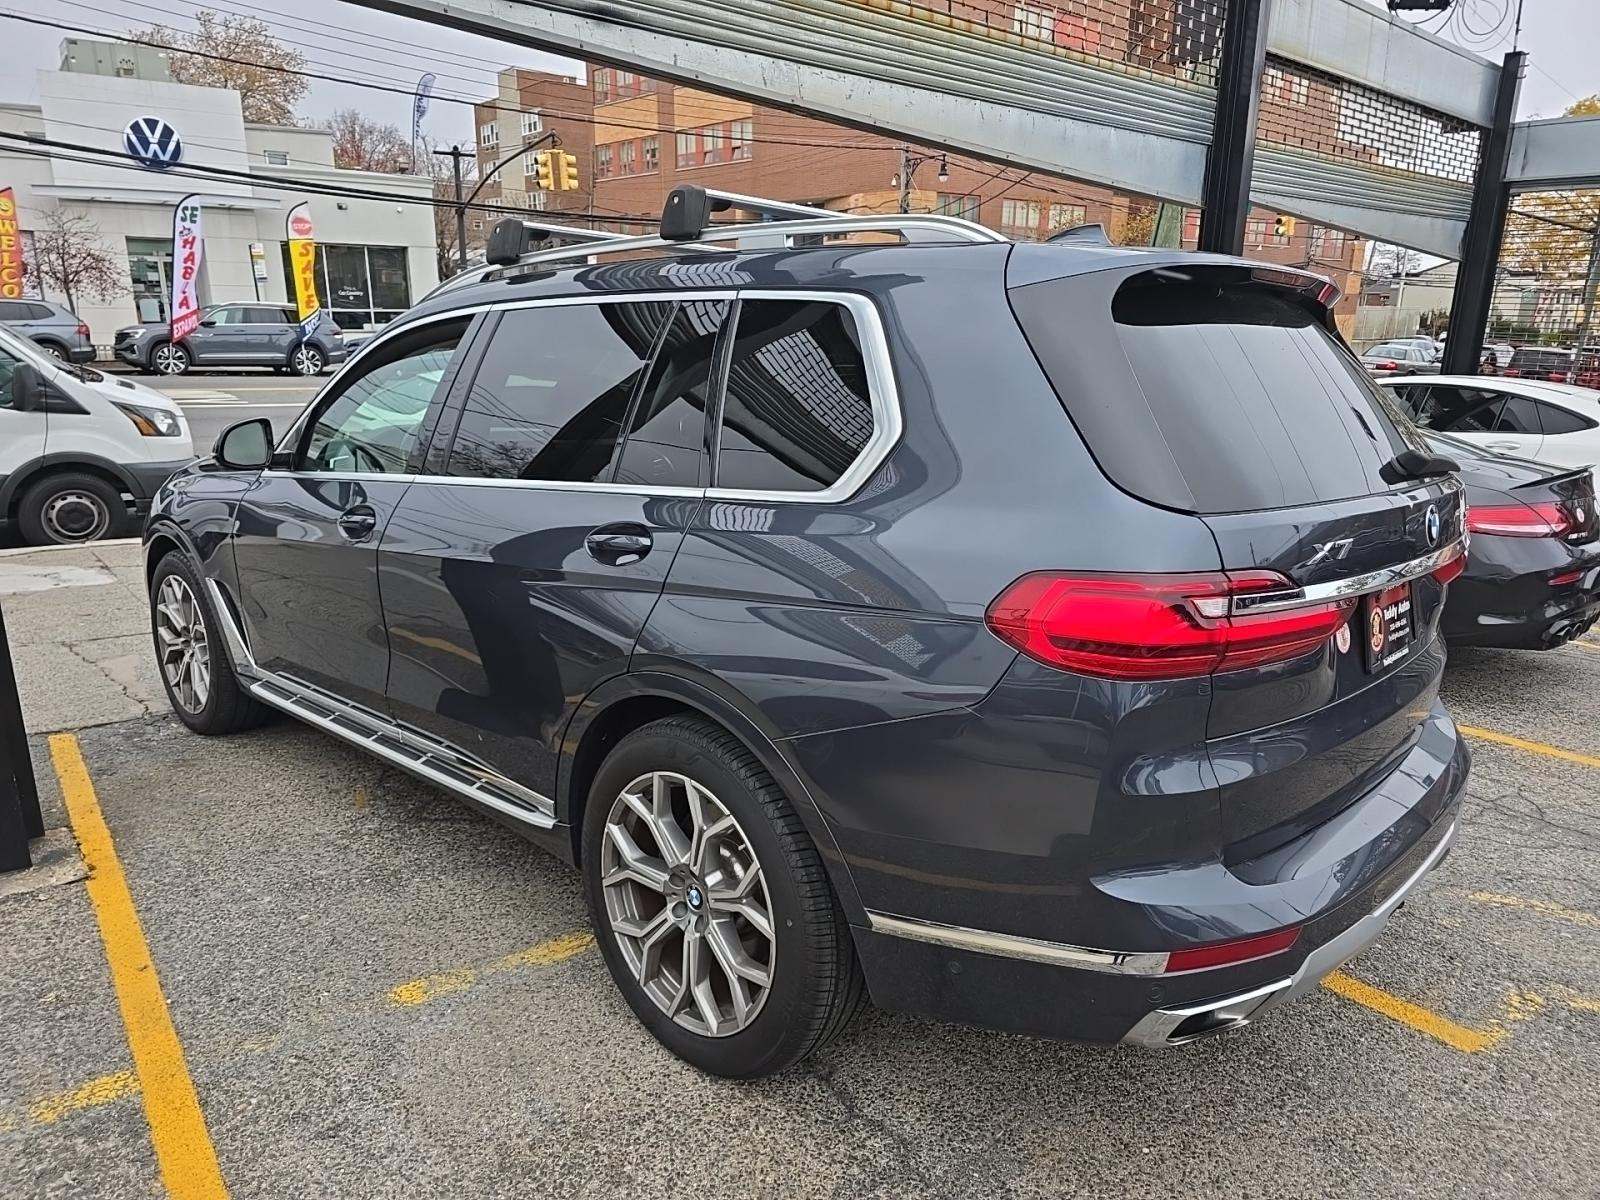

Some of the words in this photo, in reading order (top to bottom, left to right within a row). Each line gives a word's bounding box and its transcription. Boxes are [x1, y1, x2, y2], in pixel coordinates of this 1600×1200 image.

[180, 206, 199, 225] SE
[300, 241, 315, 309] SAVE
[1305, 538, 1354, 566] X7
